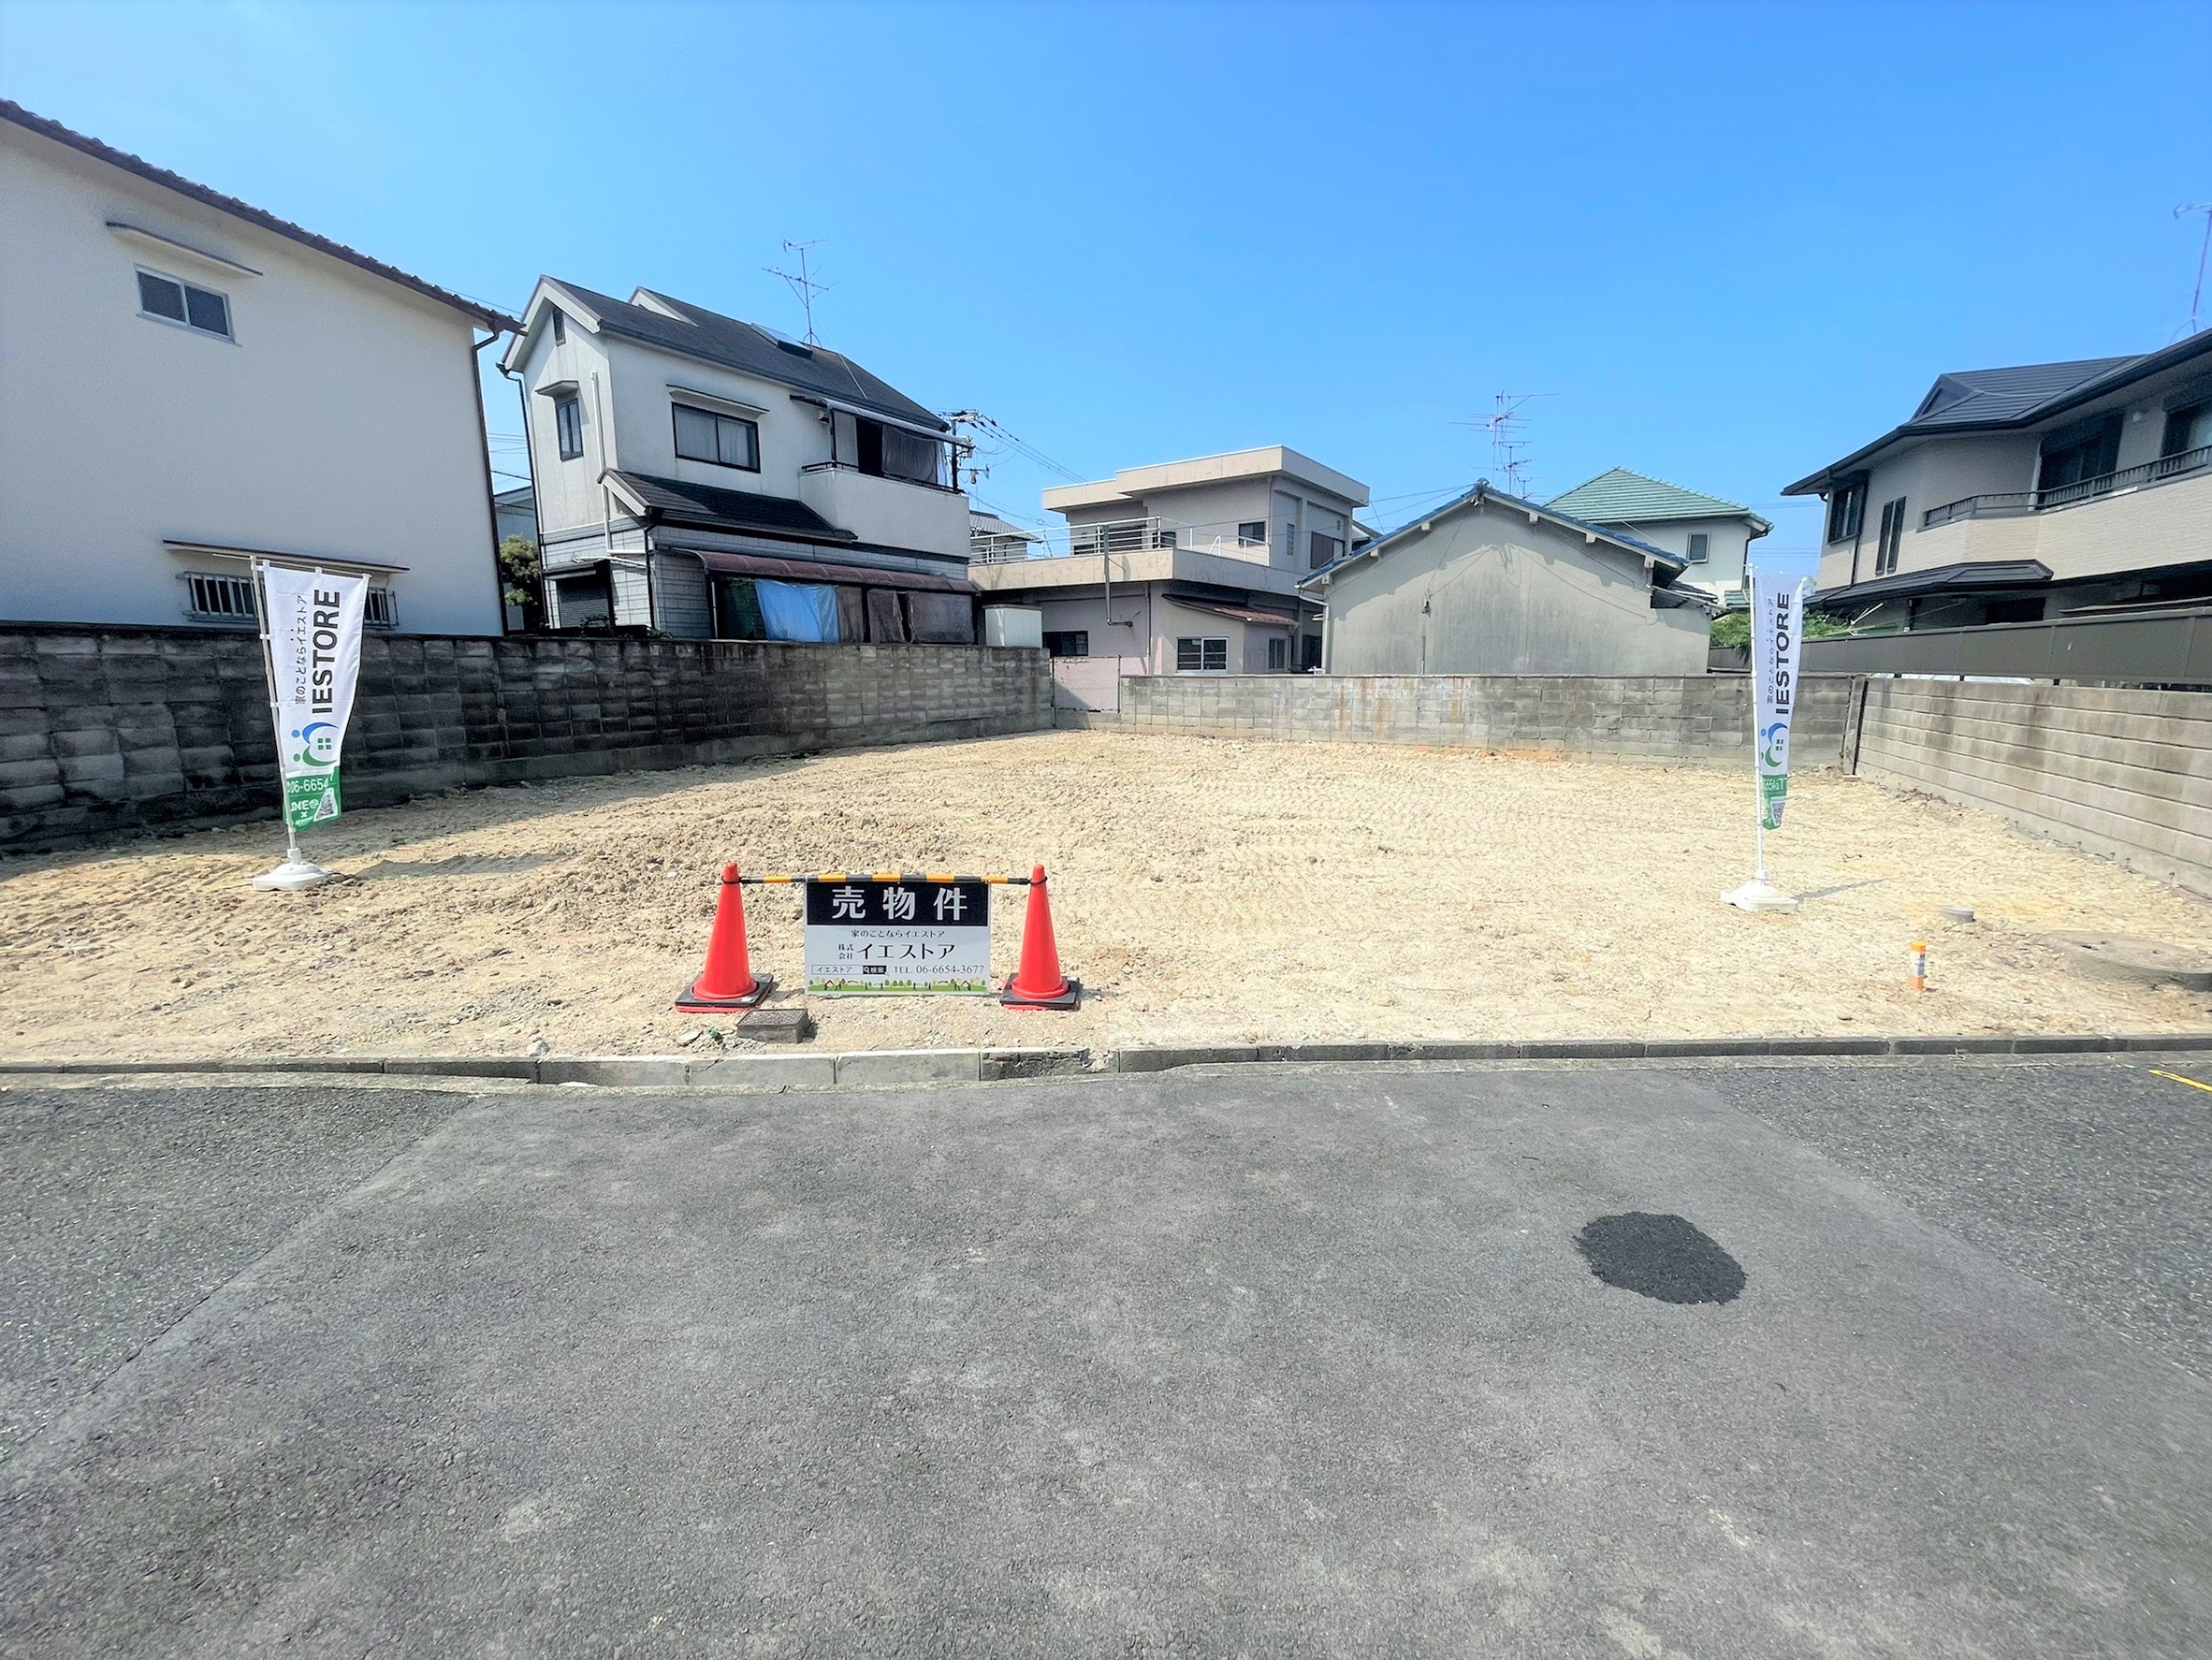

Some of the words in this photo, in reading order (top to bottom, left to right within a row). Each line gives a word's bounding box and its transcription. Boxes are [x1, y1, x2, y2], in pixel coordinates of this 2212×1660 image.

[295, 595, 308, 705] 家のことならイエストア
[312, 589, 341, 714] IESTORE
[1775, 592, 1790, 715] IESTORE
[832, 885, 968, 921] 売物件
[851, 928, 945, 938] 家のことならイエストア
[838, 943, 854, 952] 株式
[838, 952, 853, 960] 会社
[856, 942, 955, 960] イエストア
[915, 964, 985, 974] 06-6654-3677
